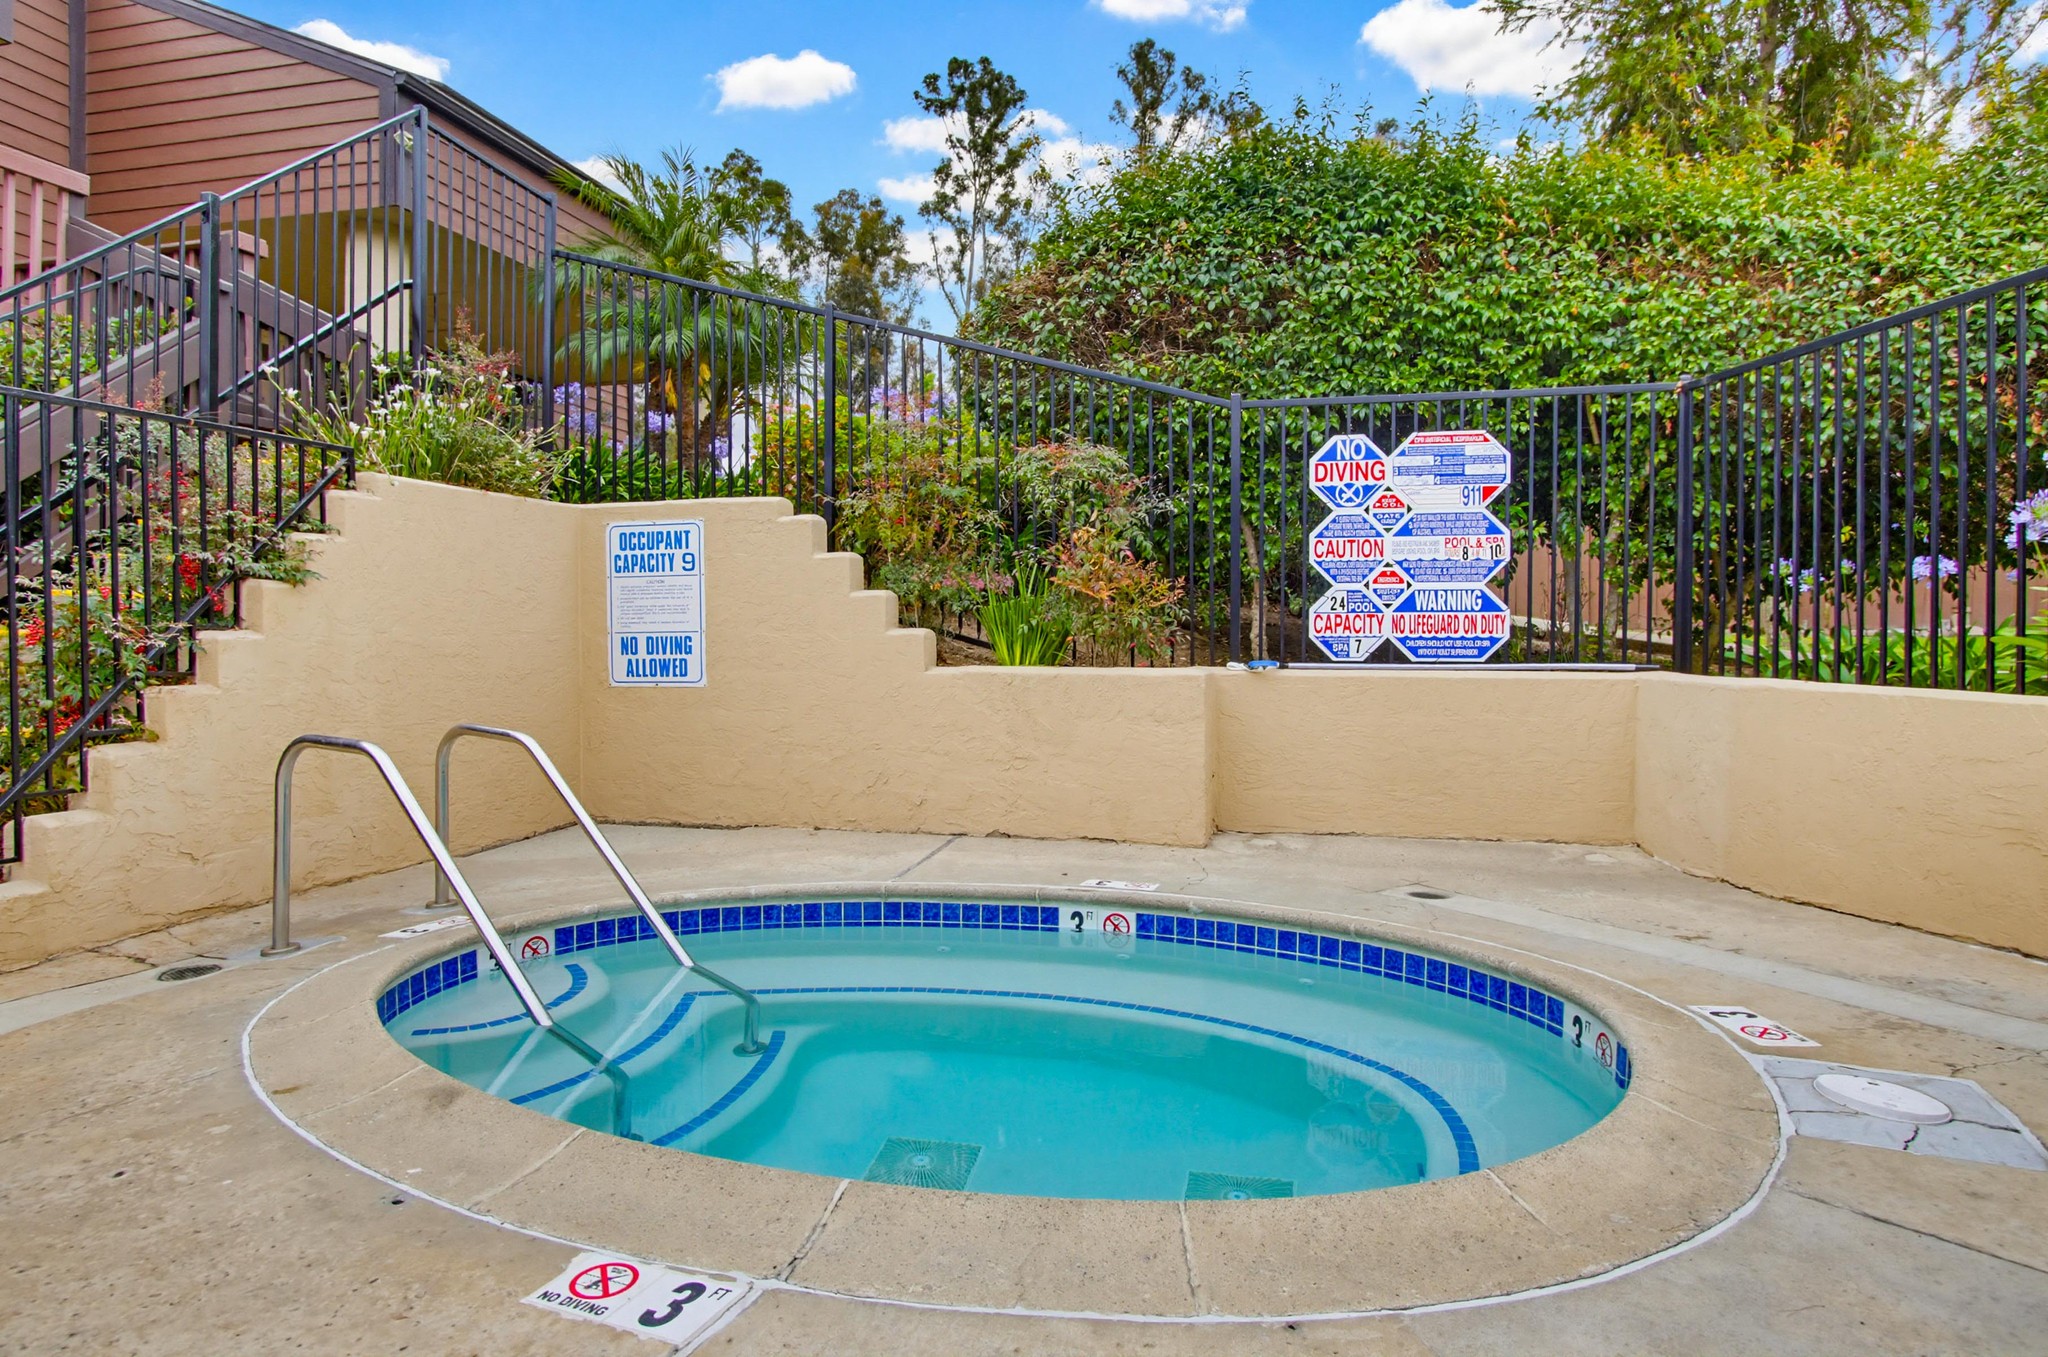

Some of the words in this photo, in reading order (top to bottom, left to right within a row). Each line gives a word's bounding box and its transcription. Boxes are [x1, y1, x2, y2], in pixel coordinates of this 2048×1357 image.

[1336, 439, 1366, 460] NO
[1434, 456, 1441, 465] 2
[1315, 461, 1385, 482] DIVING
[1462, 485, 1481, 506] 911
[619, 530, 691, 551] OCCUPANT
[1314, 540, 1384, 558] CAUTION
[1445, 537, 1473, 548] POOL
[1475, 537, 1483, 548] &
[614, 553, 675, 573] CAPACITY
[682, 553, 696, 572] 9
[1462, 546, 1468, 560] 8
[1330, 596, 1346, 611] 24
[1349, 603, 1376, 611] POOL
[1415, 590, 1482, 611] WARNING
[1314, 614, 1384, 634] CAPACITY
[1392, 614, 1406, 634] NO
[1409, 614, 1459, 634] LIFEGUARD
[1463, 614, 1477, 634] ON
[1481, 614, 1506, 634] DUTY
[620, 636, 638, 655] NO
[646, 635, 693, 655] DIVING
[1333, 643, 1348, 652] SPA
[1355, 639, 1362, 653] 7
[626, 658, 688, 677] ALLOWED
[1070, 911, 1084, 932] 3
[1086, 911, 1093, 920] FT
[1572, 1014, 1583, 1048] 3
[1585, 1020, 1591, 1034] FT
[537, 1290, 561, 1303] NO
[560, 1296, 609, 1316] DIVING
[638, 1281, 707, 1327] 3
[708, 1288, 733, 1301] FT
